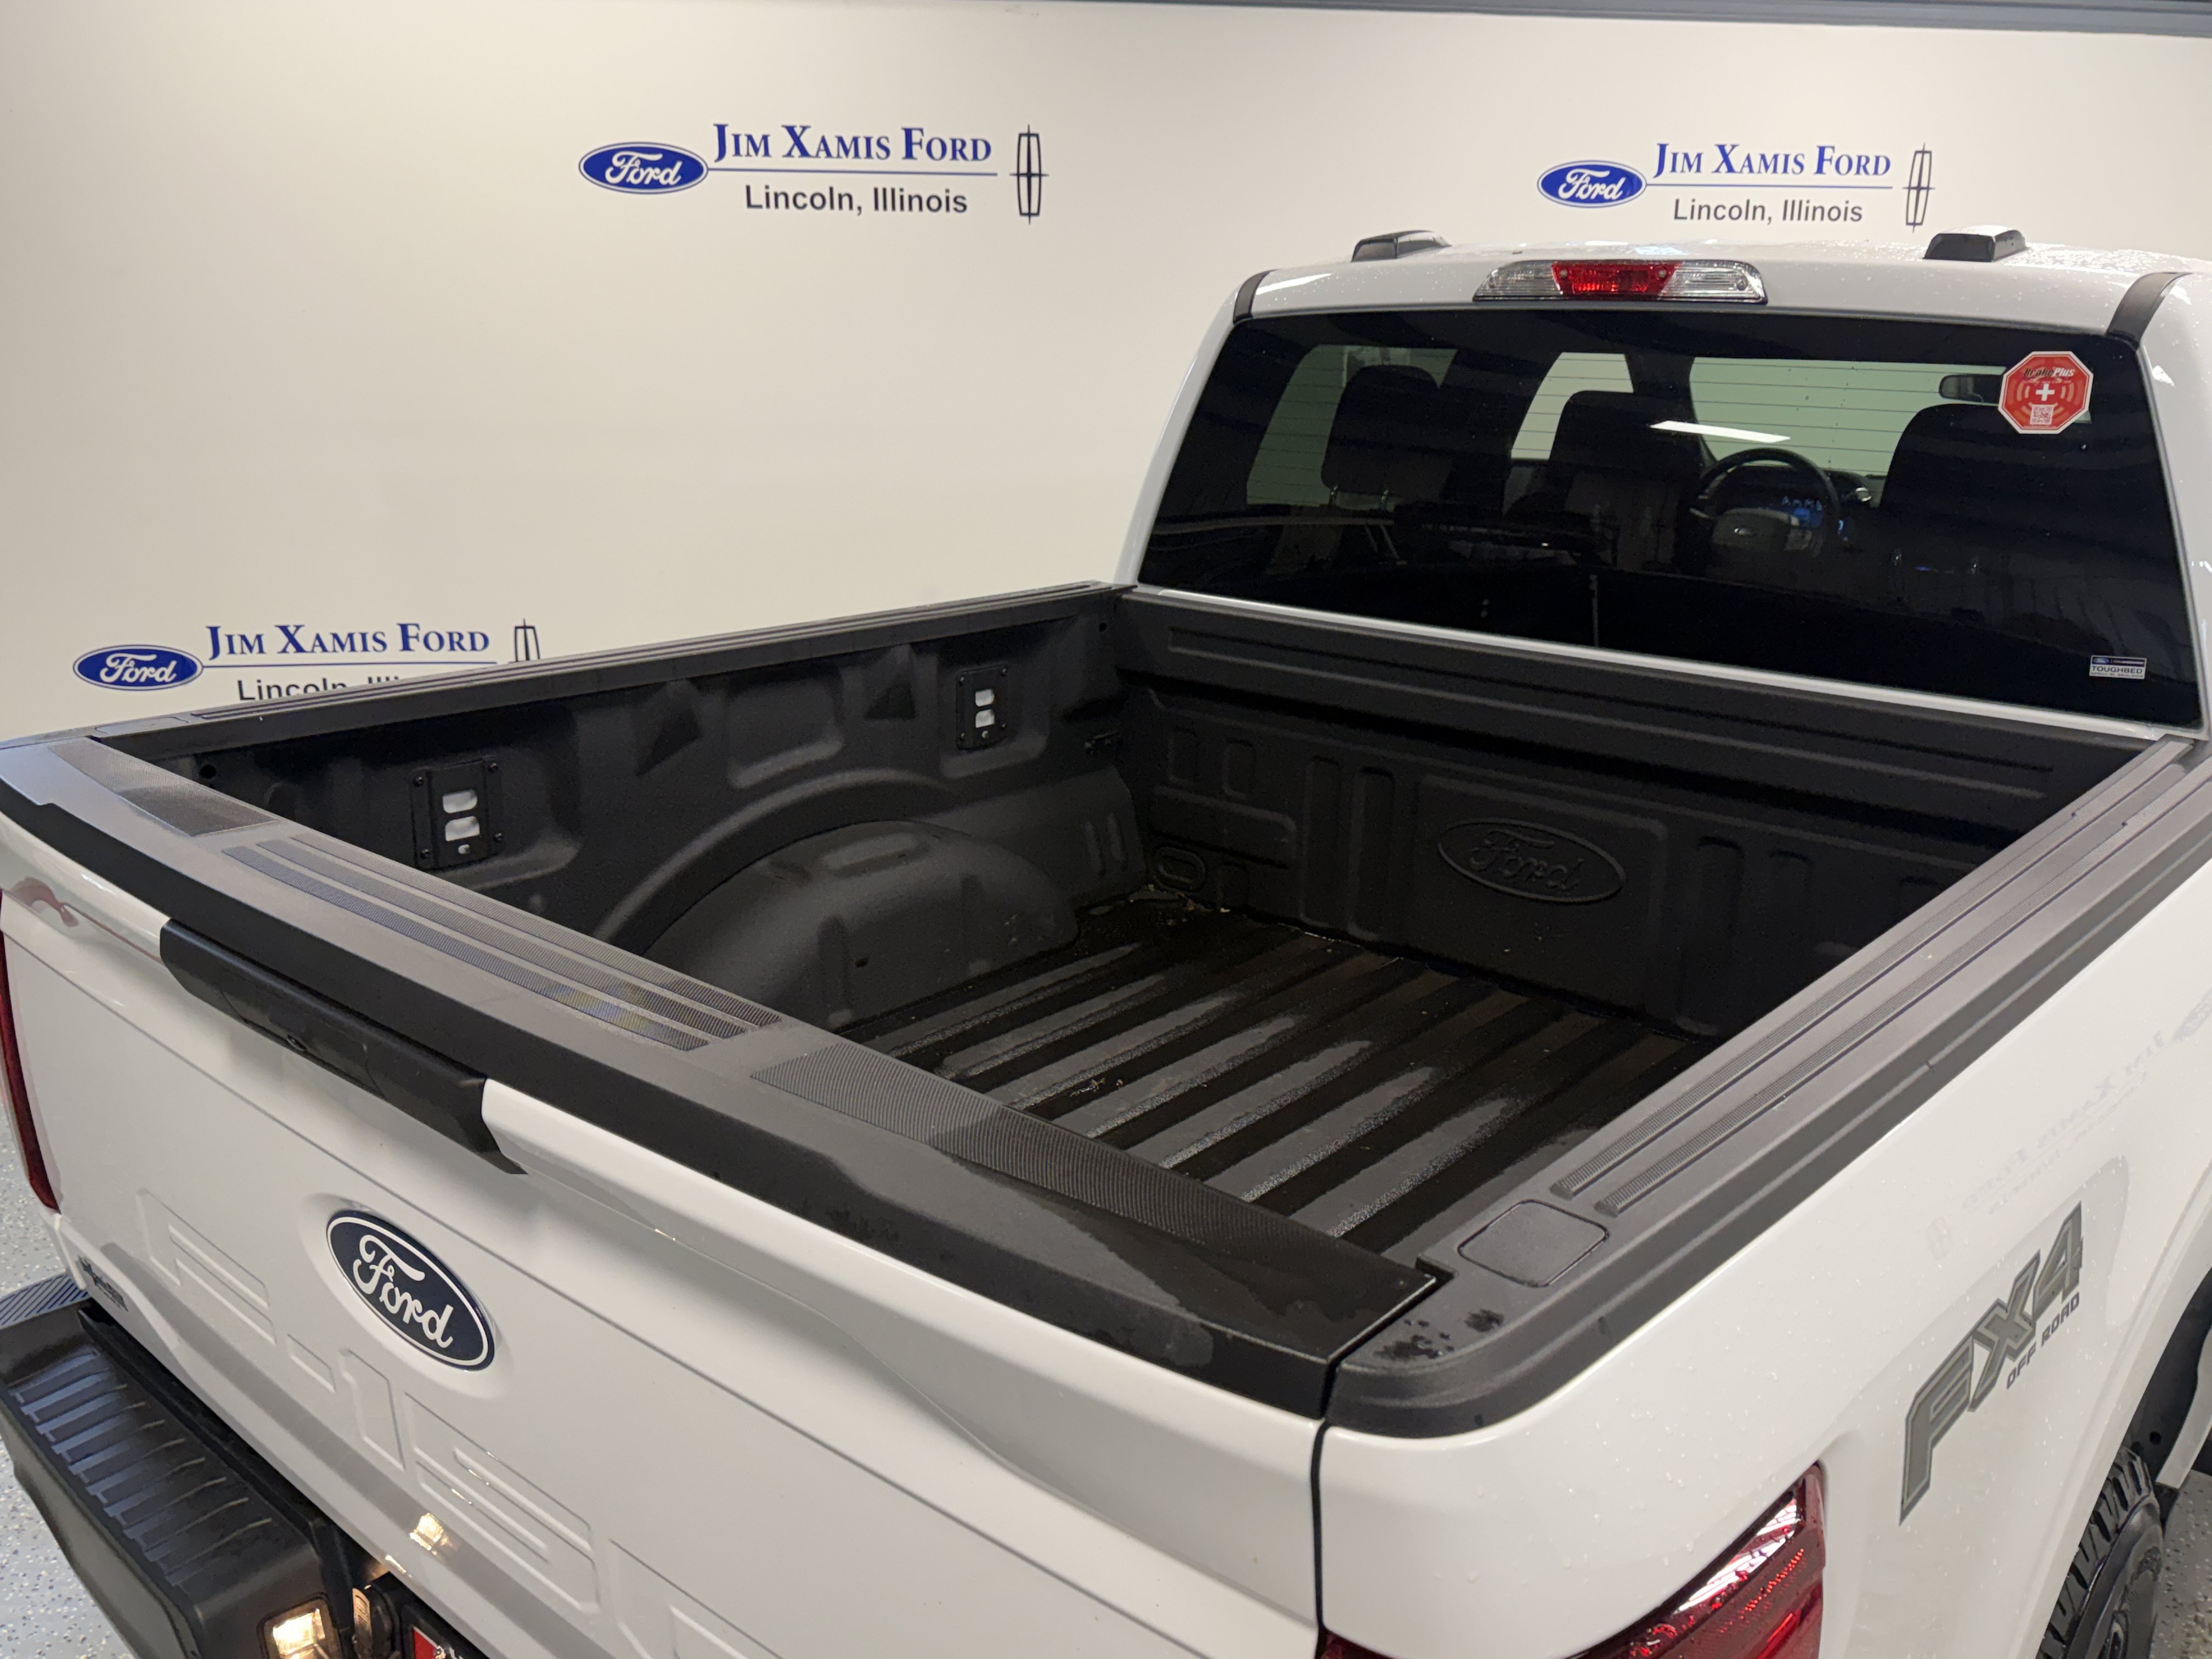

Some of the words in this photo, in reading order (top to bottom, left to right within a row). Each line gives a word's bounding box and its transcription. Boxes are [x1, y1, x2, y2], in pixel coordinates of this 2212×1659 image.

[605, 150, 683, 185] Ford
[1558, 168, 1627, 201] Ford
[745, 184, 863, 216] Lincoln,
[873, 187, 969, 214] Illinois
[1673, 198, 1773, 225] Lincoln,
[1782, 199, 1864, 223] Illinois
[99, 652, 178, 684] Ford
[2092, 665, 2143, 674] TOUGHBED
[1469, 827, 1585, 891] Ford
[352, 1234, 454, 1348] Ford
[2006, 1340, 2036, 1390] OFF
[2041, 1291, 2080, 1348] ROAD
[1899, 1200, 2084, 1527] FX4
